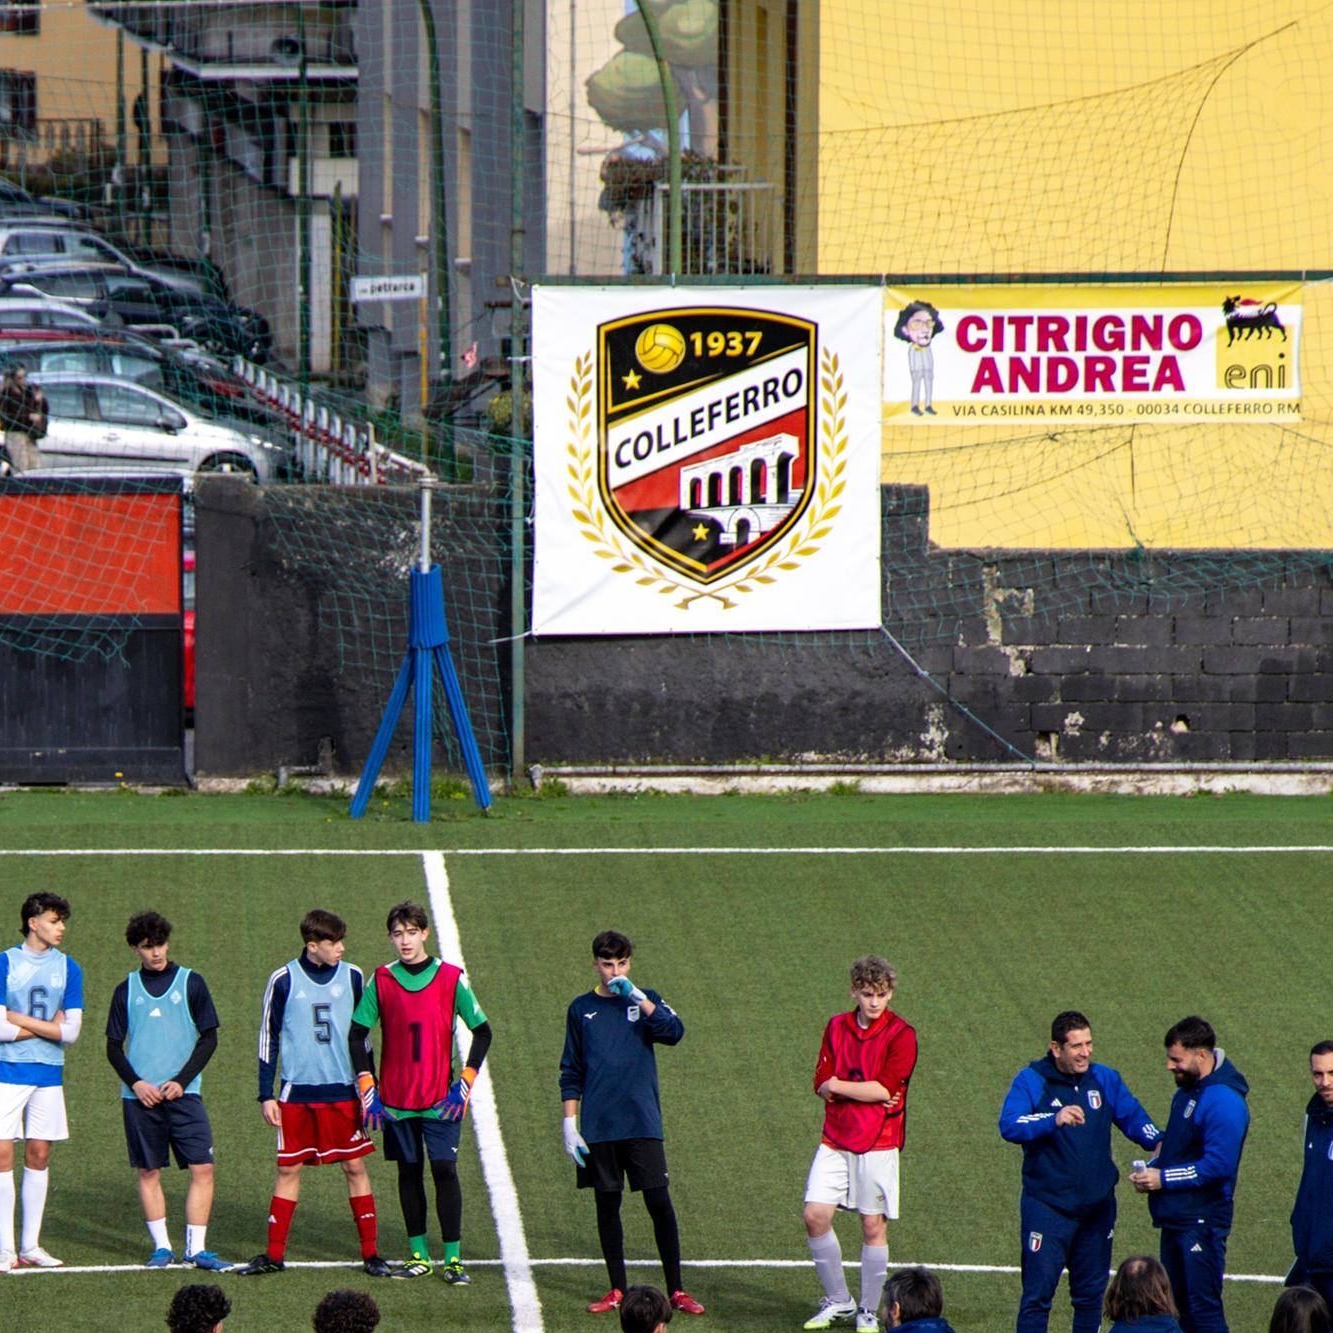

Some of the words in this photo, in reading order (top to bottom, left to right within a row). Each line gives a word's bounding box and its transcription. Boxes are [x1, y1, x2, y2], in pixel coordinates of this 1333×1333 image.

[690, 331, 763, 358] 1937
[955, 314, 1203, 353] CITRIGNO
[970, 355, 1186, 394] ANDREA
[1224, 352, 1286, 390] eni
[614, 367, 803, 469] COLLEFERRO
[953, 405, 977, 416] VIA
[981, 404, 1046, 416] CASILINA
[1050, 404, 1073, 416] KM
[1077, 404, 1124, 417] 49,350
[1136, 403, 1179, 416] 00034
[1183, 403, 1273, 415] COLLEFERRO
[1277, 403, 1301, 414] RM
[28, 985, 50, 1021] 6
[311, 1003, 332, 1045] 5
[409, 1022, 422, 1063] 1
